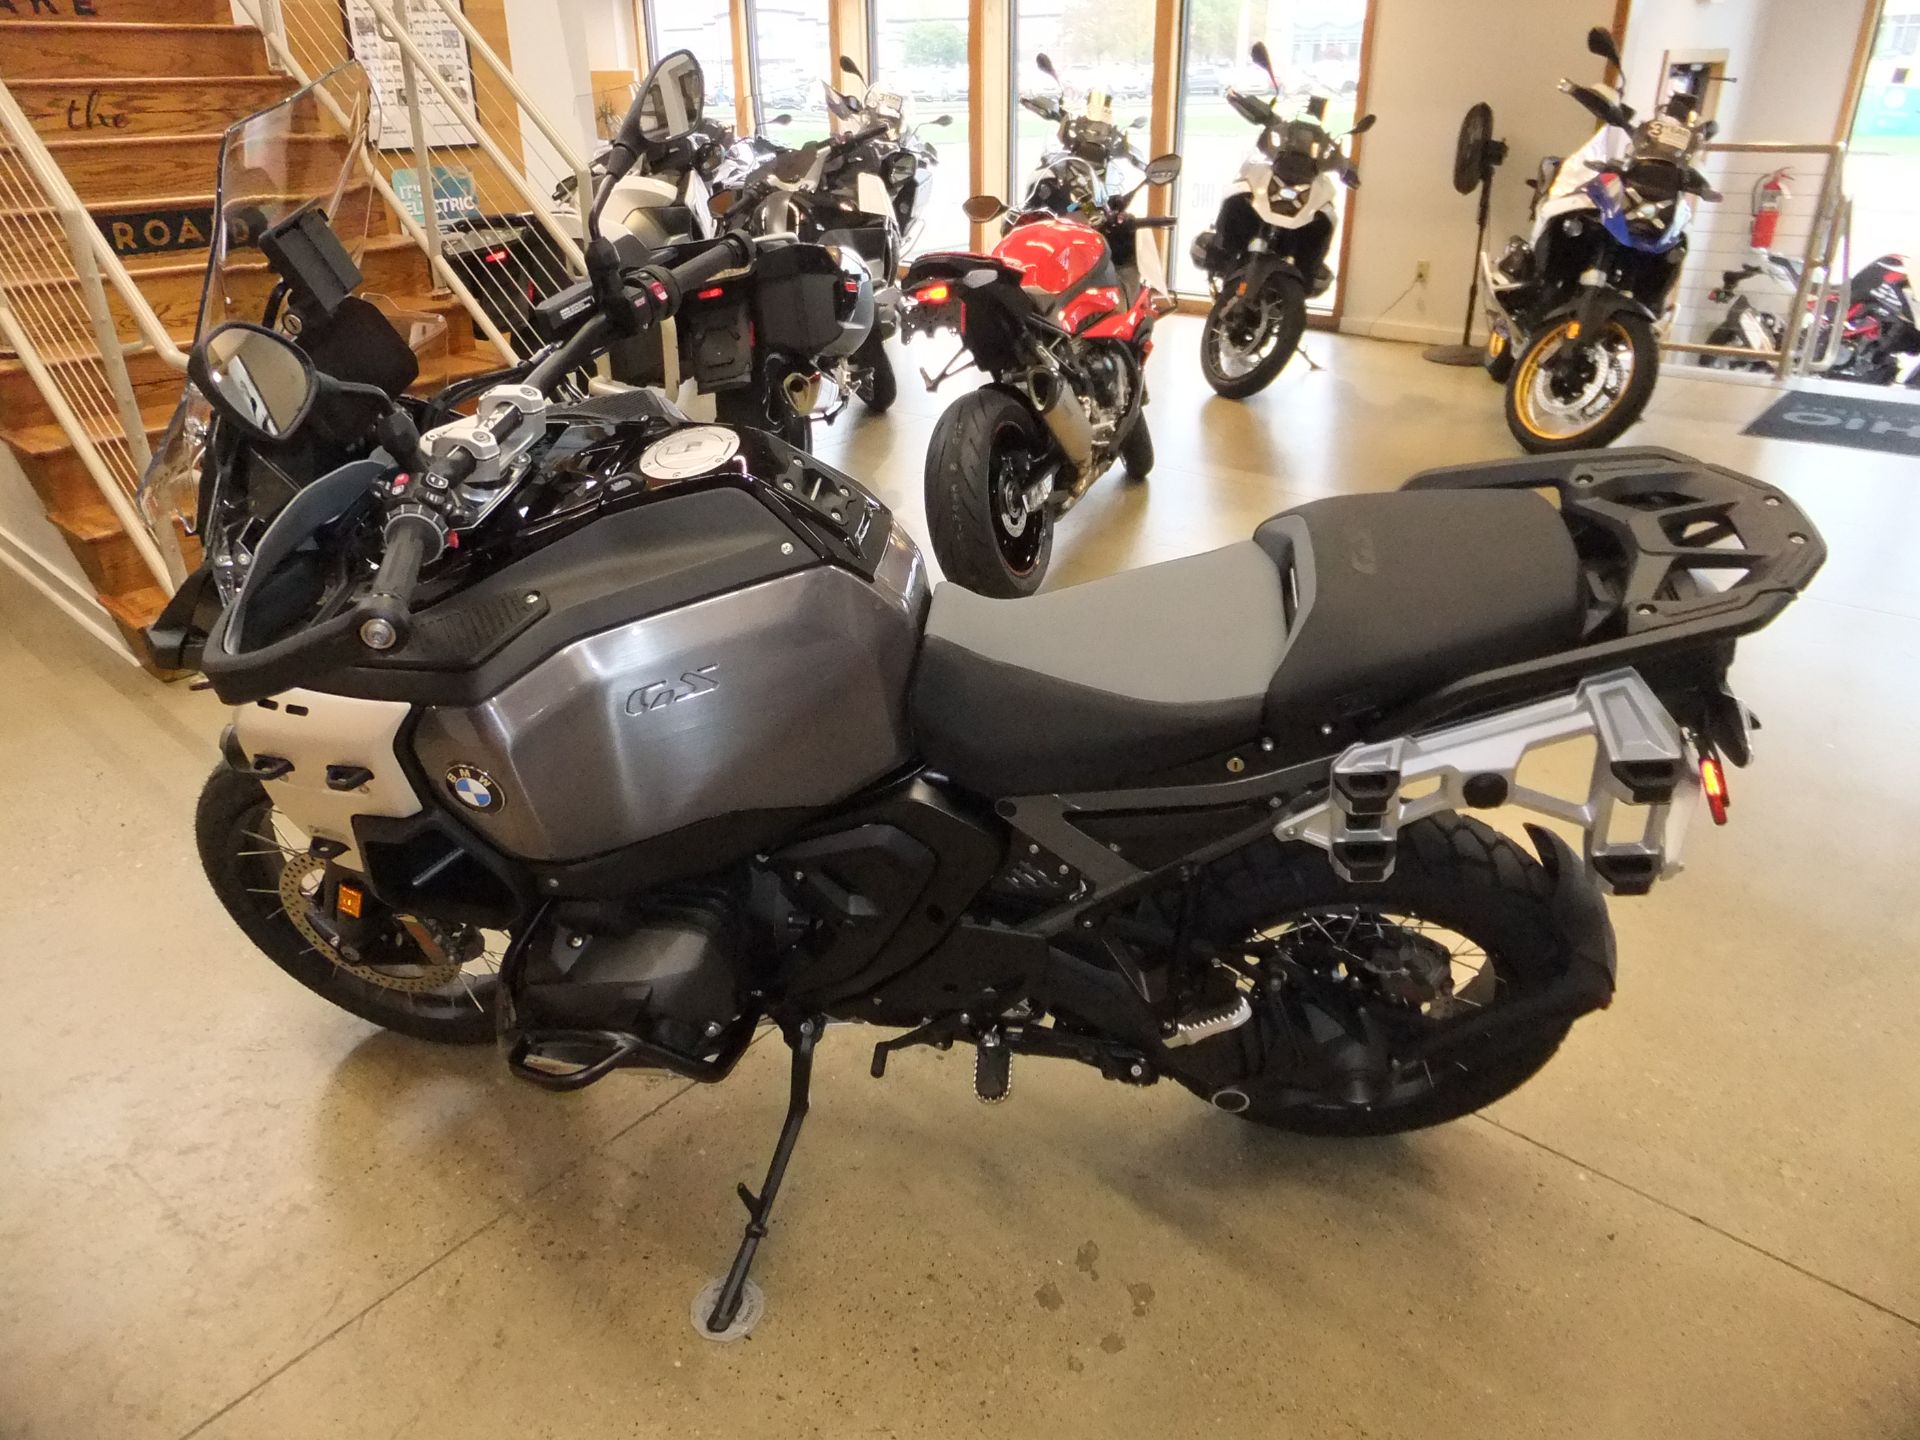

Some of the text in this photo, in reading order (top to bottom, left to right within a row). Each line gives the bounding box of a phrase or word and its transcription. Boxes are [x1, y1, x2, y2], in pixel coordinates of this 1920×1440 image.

[67, 88, 129, 129] the
[1649, 121, 1663, 137] 3
[112, 216, 249, 249] ROAD
[626, 663, 720, 716] GS
[447, 768, 491, 787] BMW
